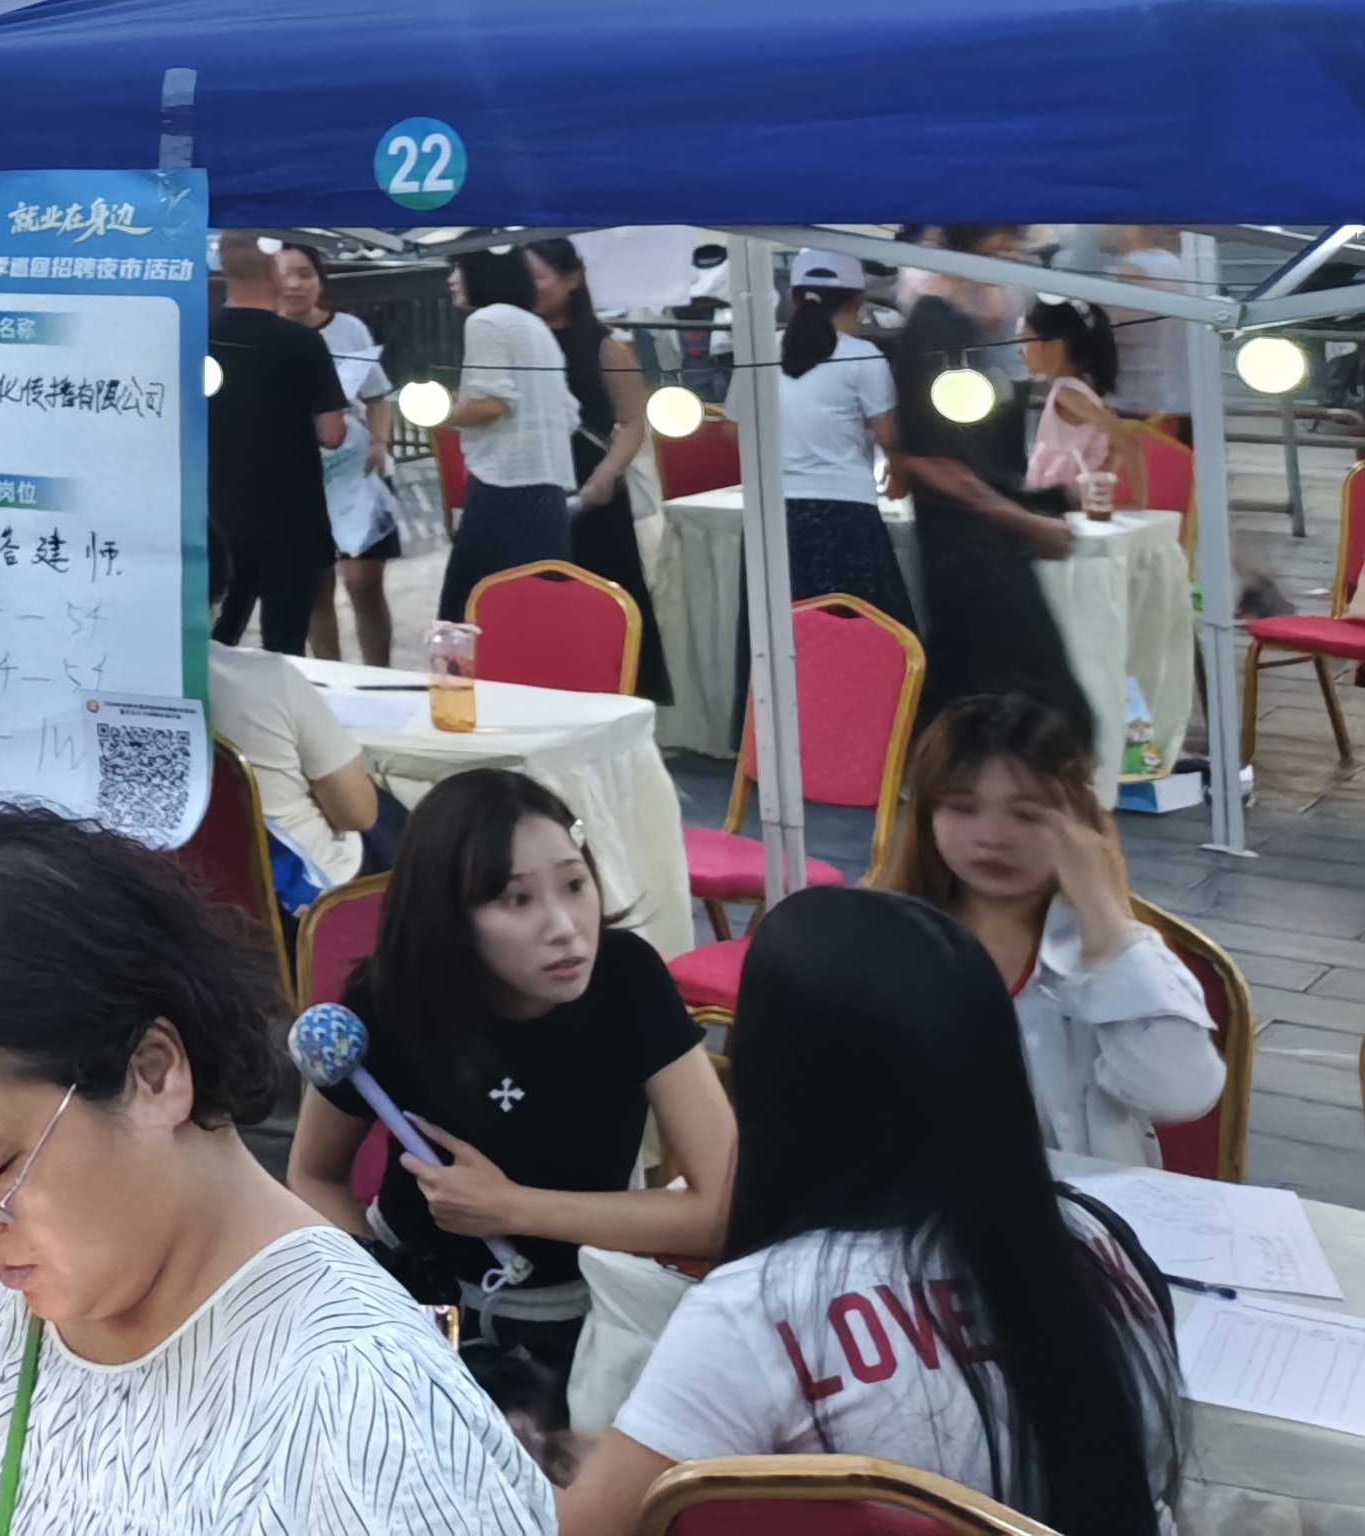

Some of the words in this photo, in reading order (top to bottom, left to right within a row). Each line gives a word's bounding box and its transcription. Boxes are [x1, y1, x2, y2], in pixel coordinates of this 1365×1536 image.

[388, 133, 454, 194] 22
[7, 196, 153, 243] 就业在身边
